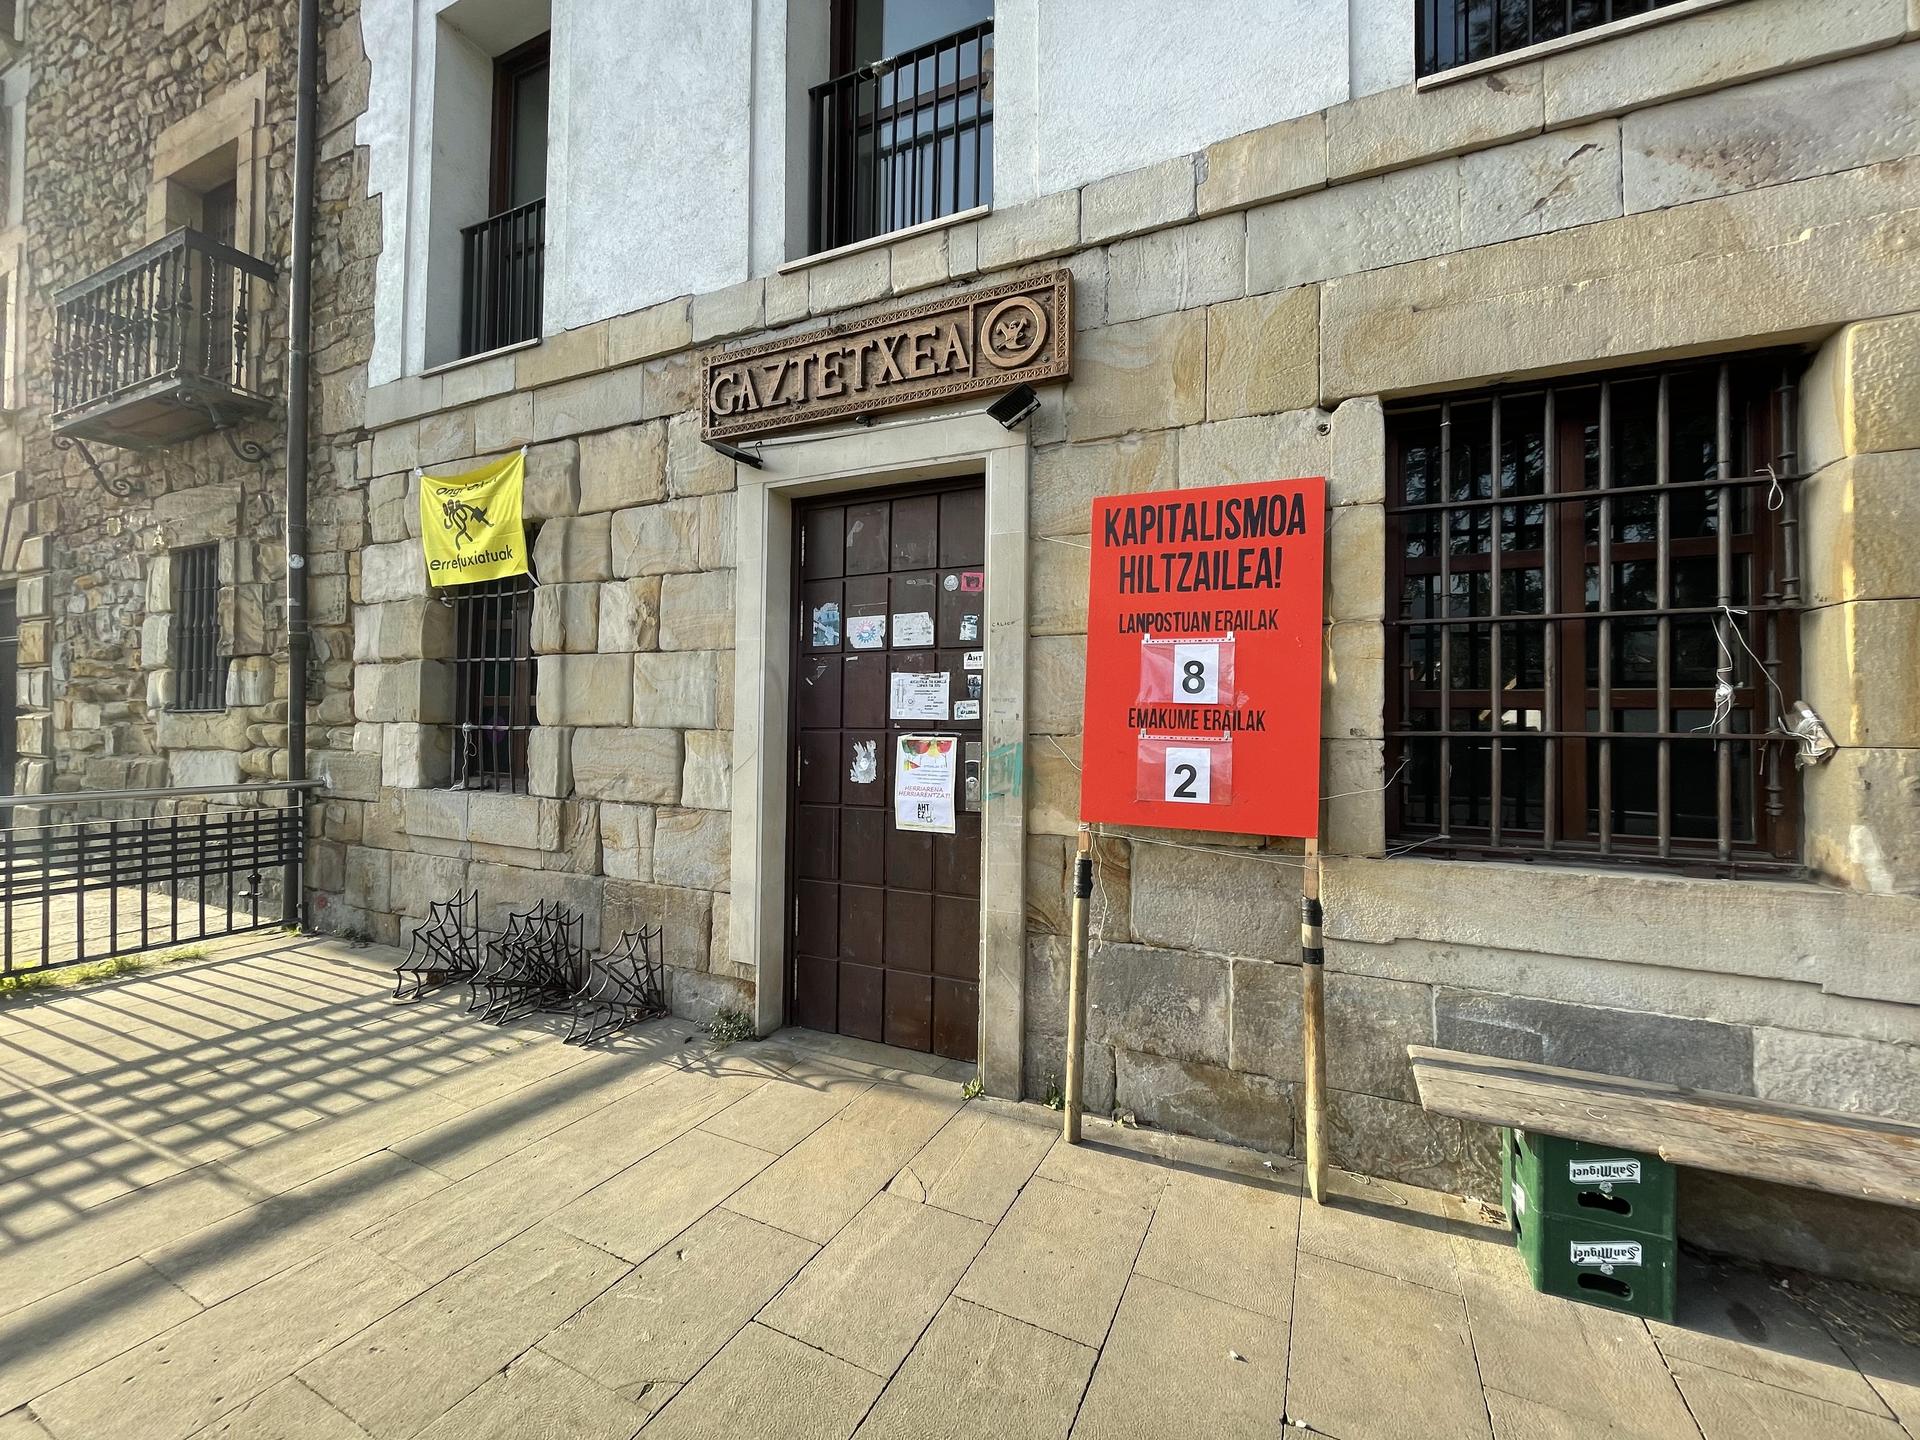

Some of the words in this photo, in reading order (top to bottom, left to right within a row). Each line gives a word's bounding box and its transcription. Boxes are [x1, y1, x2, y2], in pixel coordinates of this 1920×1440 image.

[710, 322, 970, 416] GAZTETXEA
[1104, 493, 1306, 547] KAPITALISMOA
[429, 544, 513, 572] errefuxiatuak
[1119, 546, 1283, 594] HILTZAILEA!
[1119, 611, 1210, 634] LANPOSTUAN
[1214, 609, 1279, 632] ERAILAK
[1181, 660, 1206, 694] 8
[1128, 707, 1199, 730] EMAKUME
[1203, 709, 1266, 732] ERAILAK
[1173, 764, 1197, 798] 2
[917, 803, 930, 811] AHT
[917, 811, 925, 819] EZ
